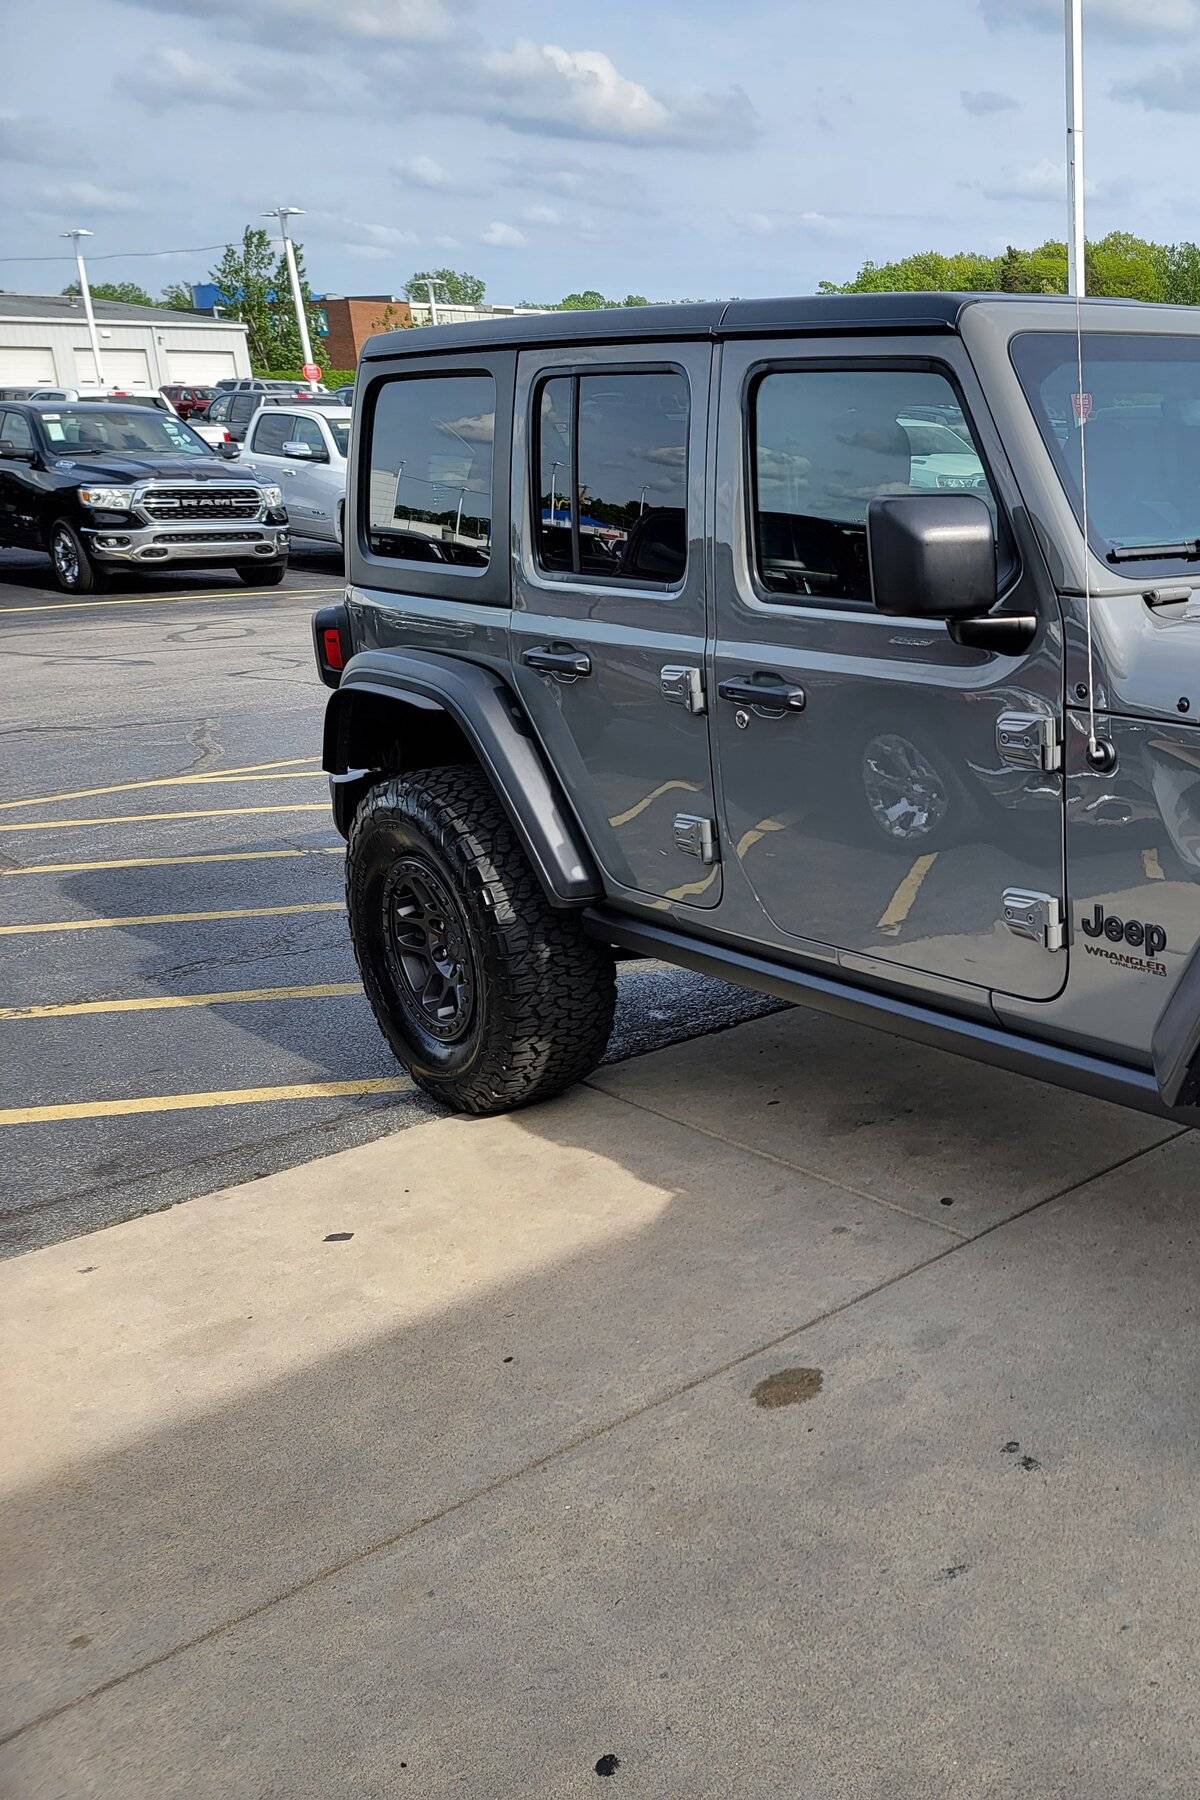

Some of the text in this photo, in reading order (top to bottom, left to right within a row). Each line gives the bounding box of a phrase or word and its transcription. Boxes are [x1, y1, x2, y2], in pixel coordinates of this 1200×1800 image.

[1081, 903, 1167, 957] Jeep
[1083, 943, 1167, 973] WRANGLER
[1109, 959, 1168, 978] UNLIMITED
